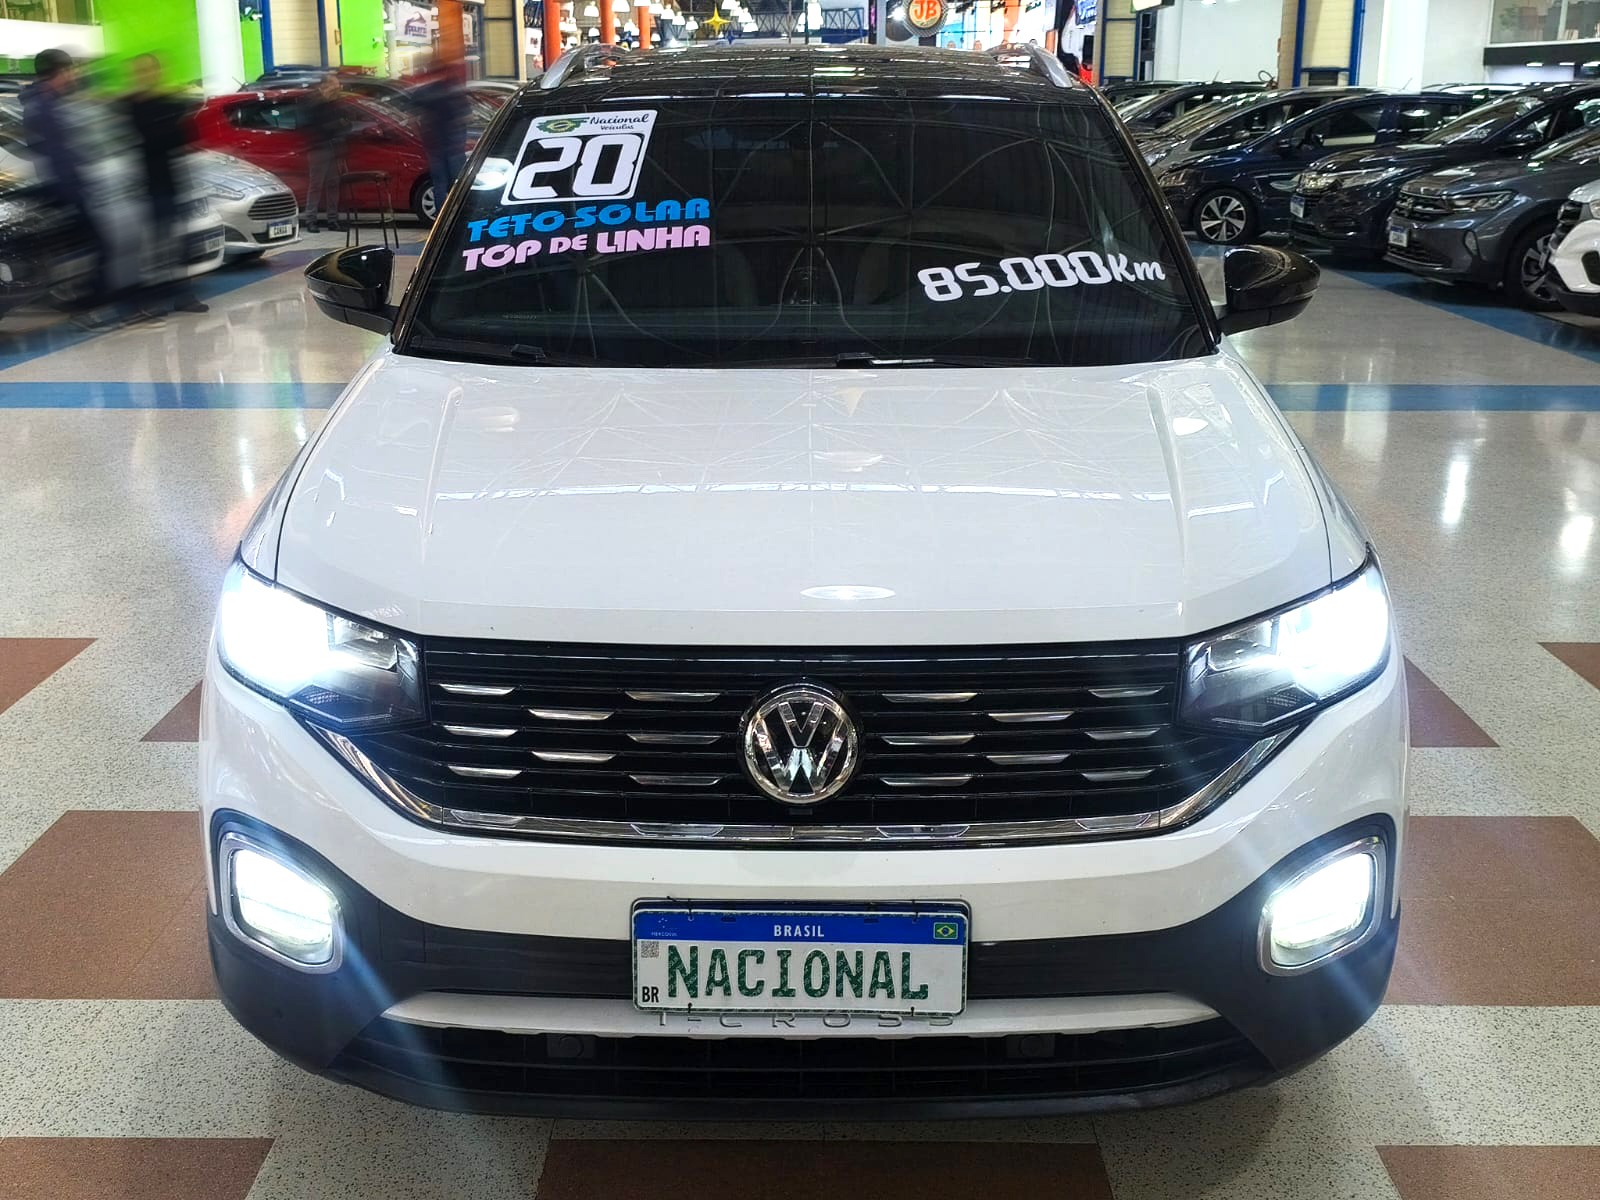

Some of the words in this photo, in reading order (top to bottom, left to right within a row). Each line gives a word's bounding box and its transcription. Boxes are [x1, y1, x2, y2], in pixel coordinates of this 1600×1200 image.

[914, 0, 937, 20] JB
[590, 113, 649, 125] Nacional
[511, 133, 643, 200] 20
[467, 210, 566, 242] TETO
[574, 197, 711, 229] SOLAR
[462, 239, 543, 272] TOP
[549, 233, 588, 255] DE
[596, 224, 711, 254] LINHA
[774, 924, 825, 937] BRASIL
[667, 944, 929, 1001] NACIONAL
[641, 986, 660, 1003] BR
